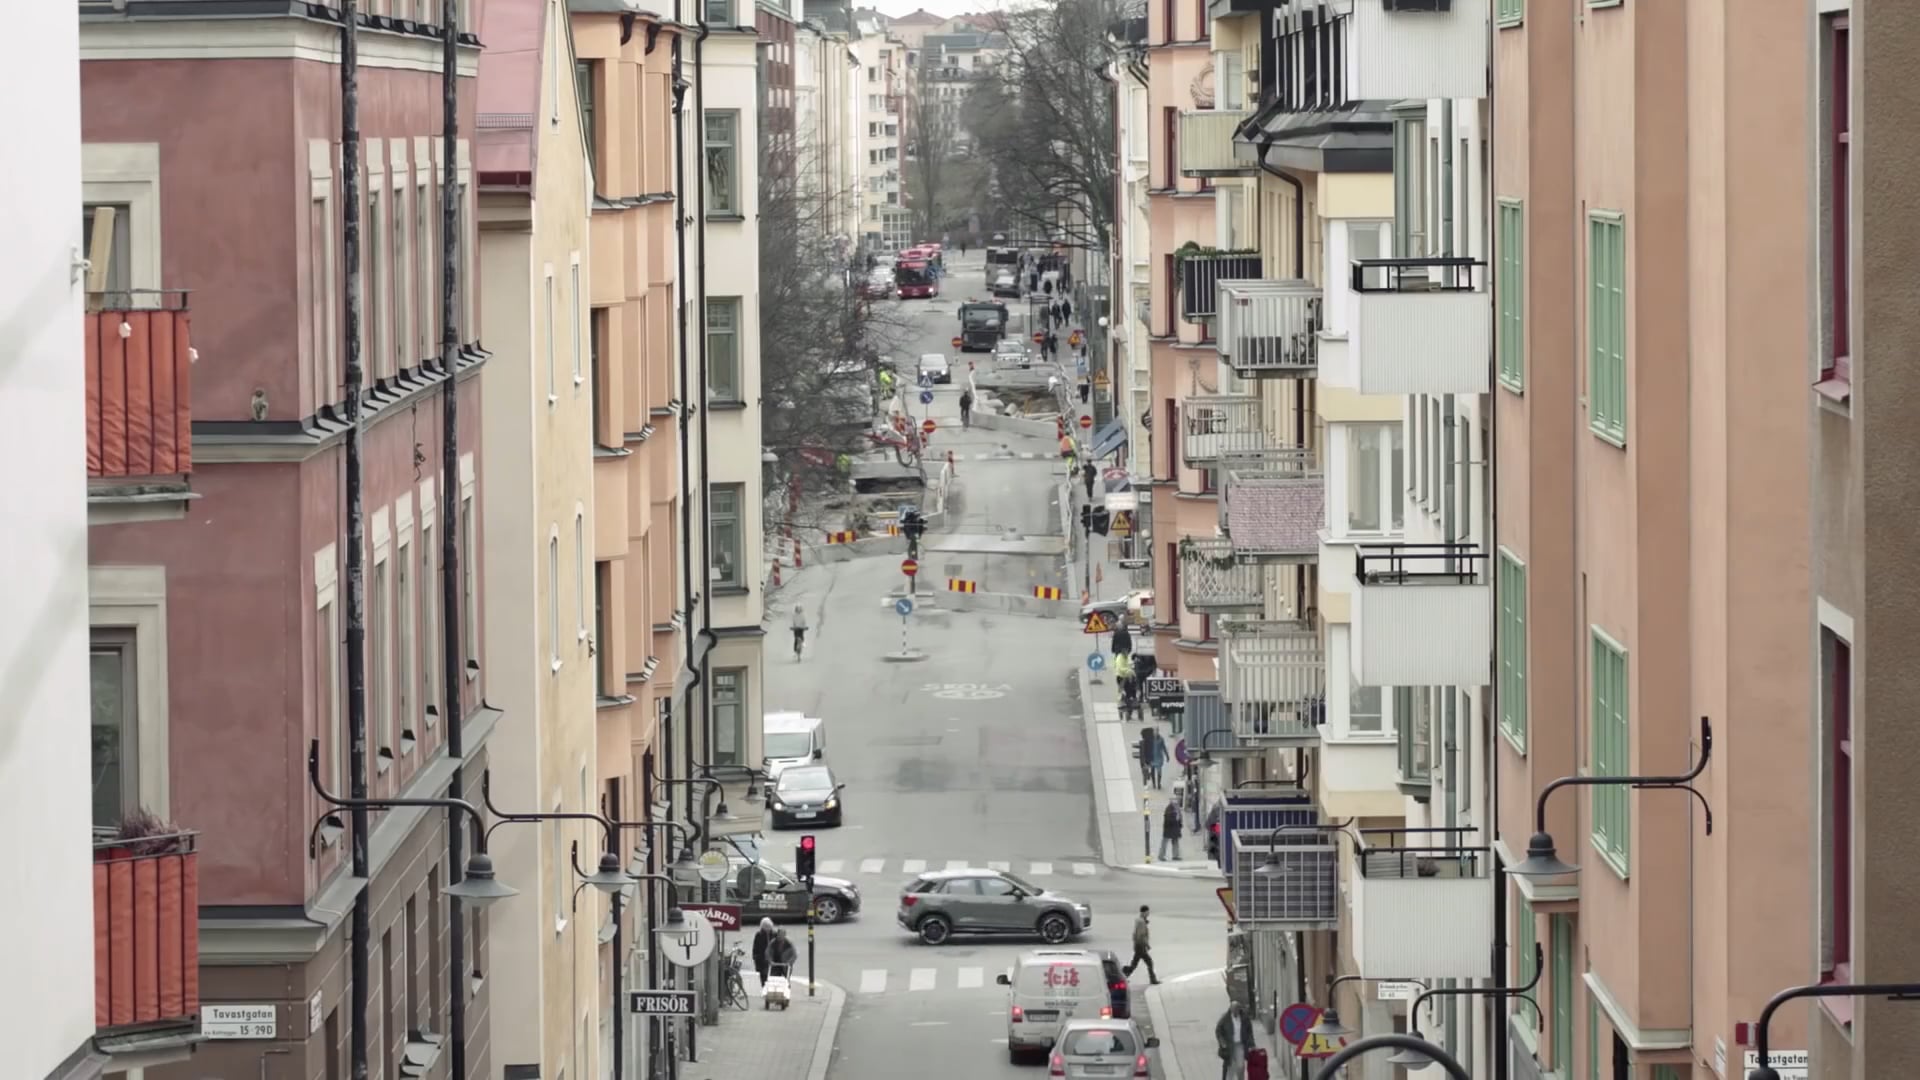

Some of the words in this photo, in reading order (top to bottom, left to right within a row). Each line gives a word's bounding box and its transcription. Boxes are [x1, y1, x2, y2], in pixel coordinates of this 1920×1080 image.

[636, 994, 689, 1012] FRISÖR
[213, 1009, 273, 1021] Tavastgatan
[1749, 1054, 1809, 1065] Taastgatan
